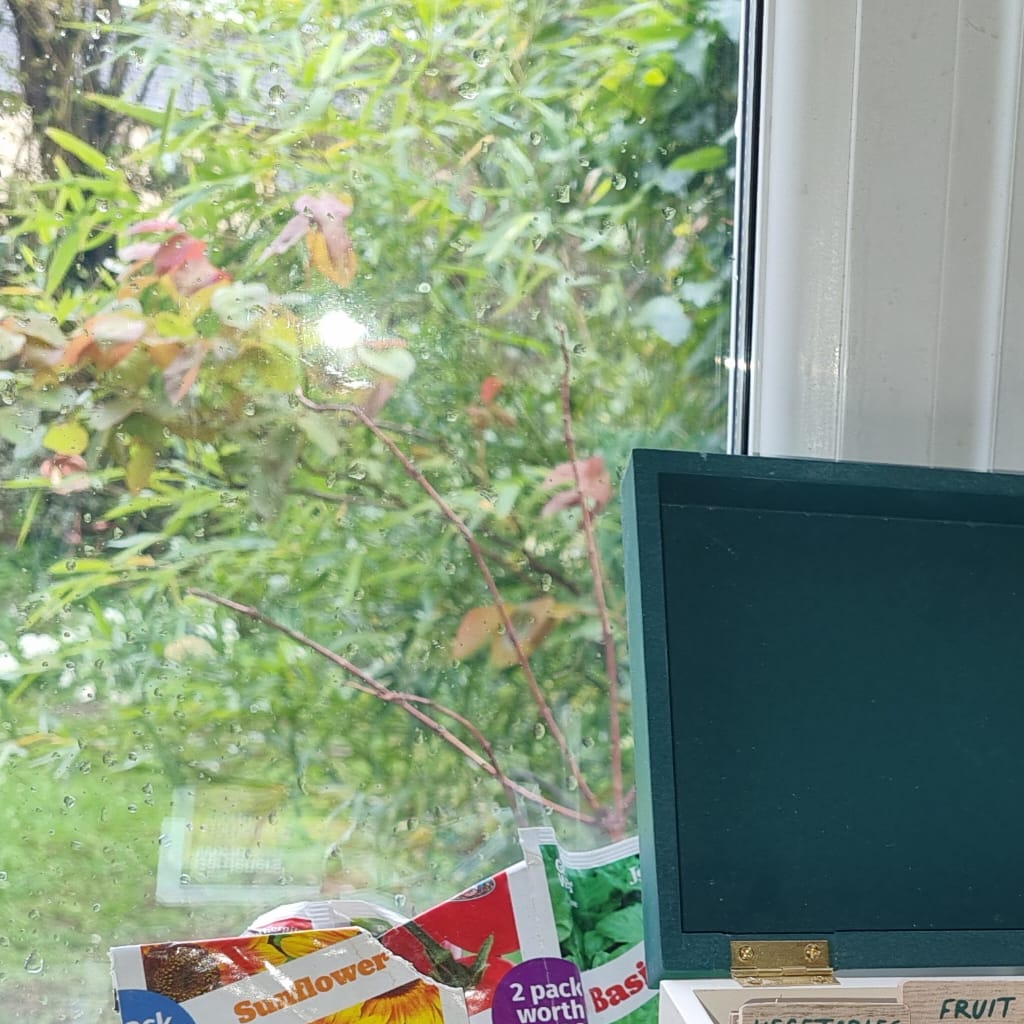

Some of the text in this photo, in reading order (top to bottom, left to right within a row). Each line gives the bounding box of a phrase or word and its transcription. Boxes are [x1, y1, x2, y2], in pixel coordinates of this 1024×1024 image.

[233, 951, 390, 1024] Sunflower
[510, 977, 583, 1005] 2 pack
[589, 961, 648, 1013] Basi
[517, 1000, 586, 1024] worth
[939, 996, 1016, 1020] FRUIT
